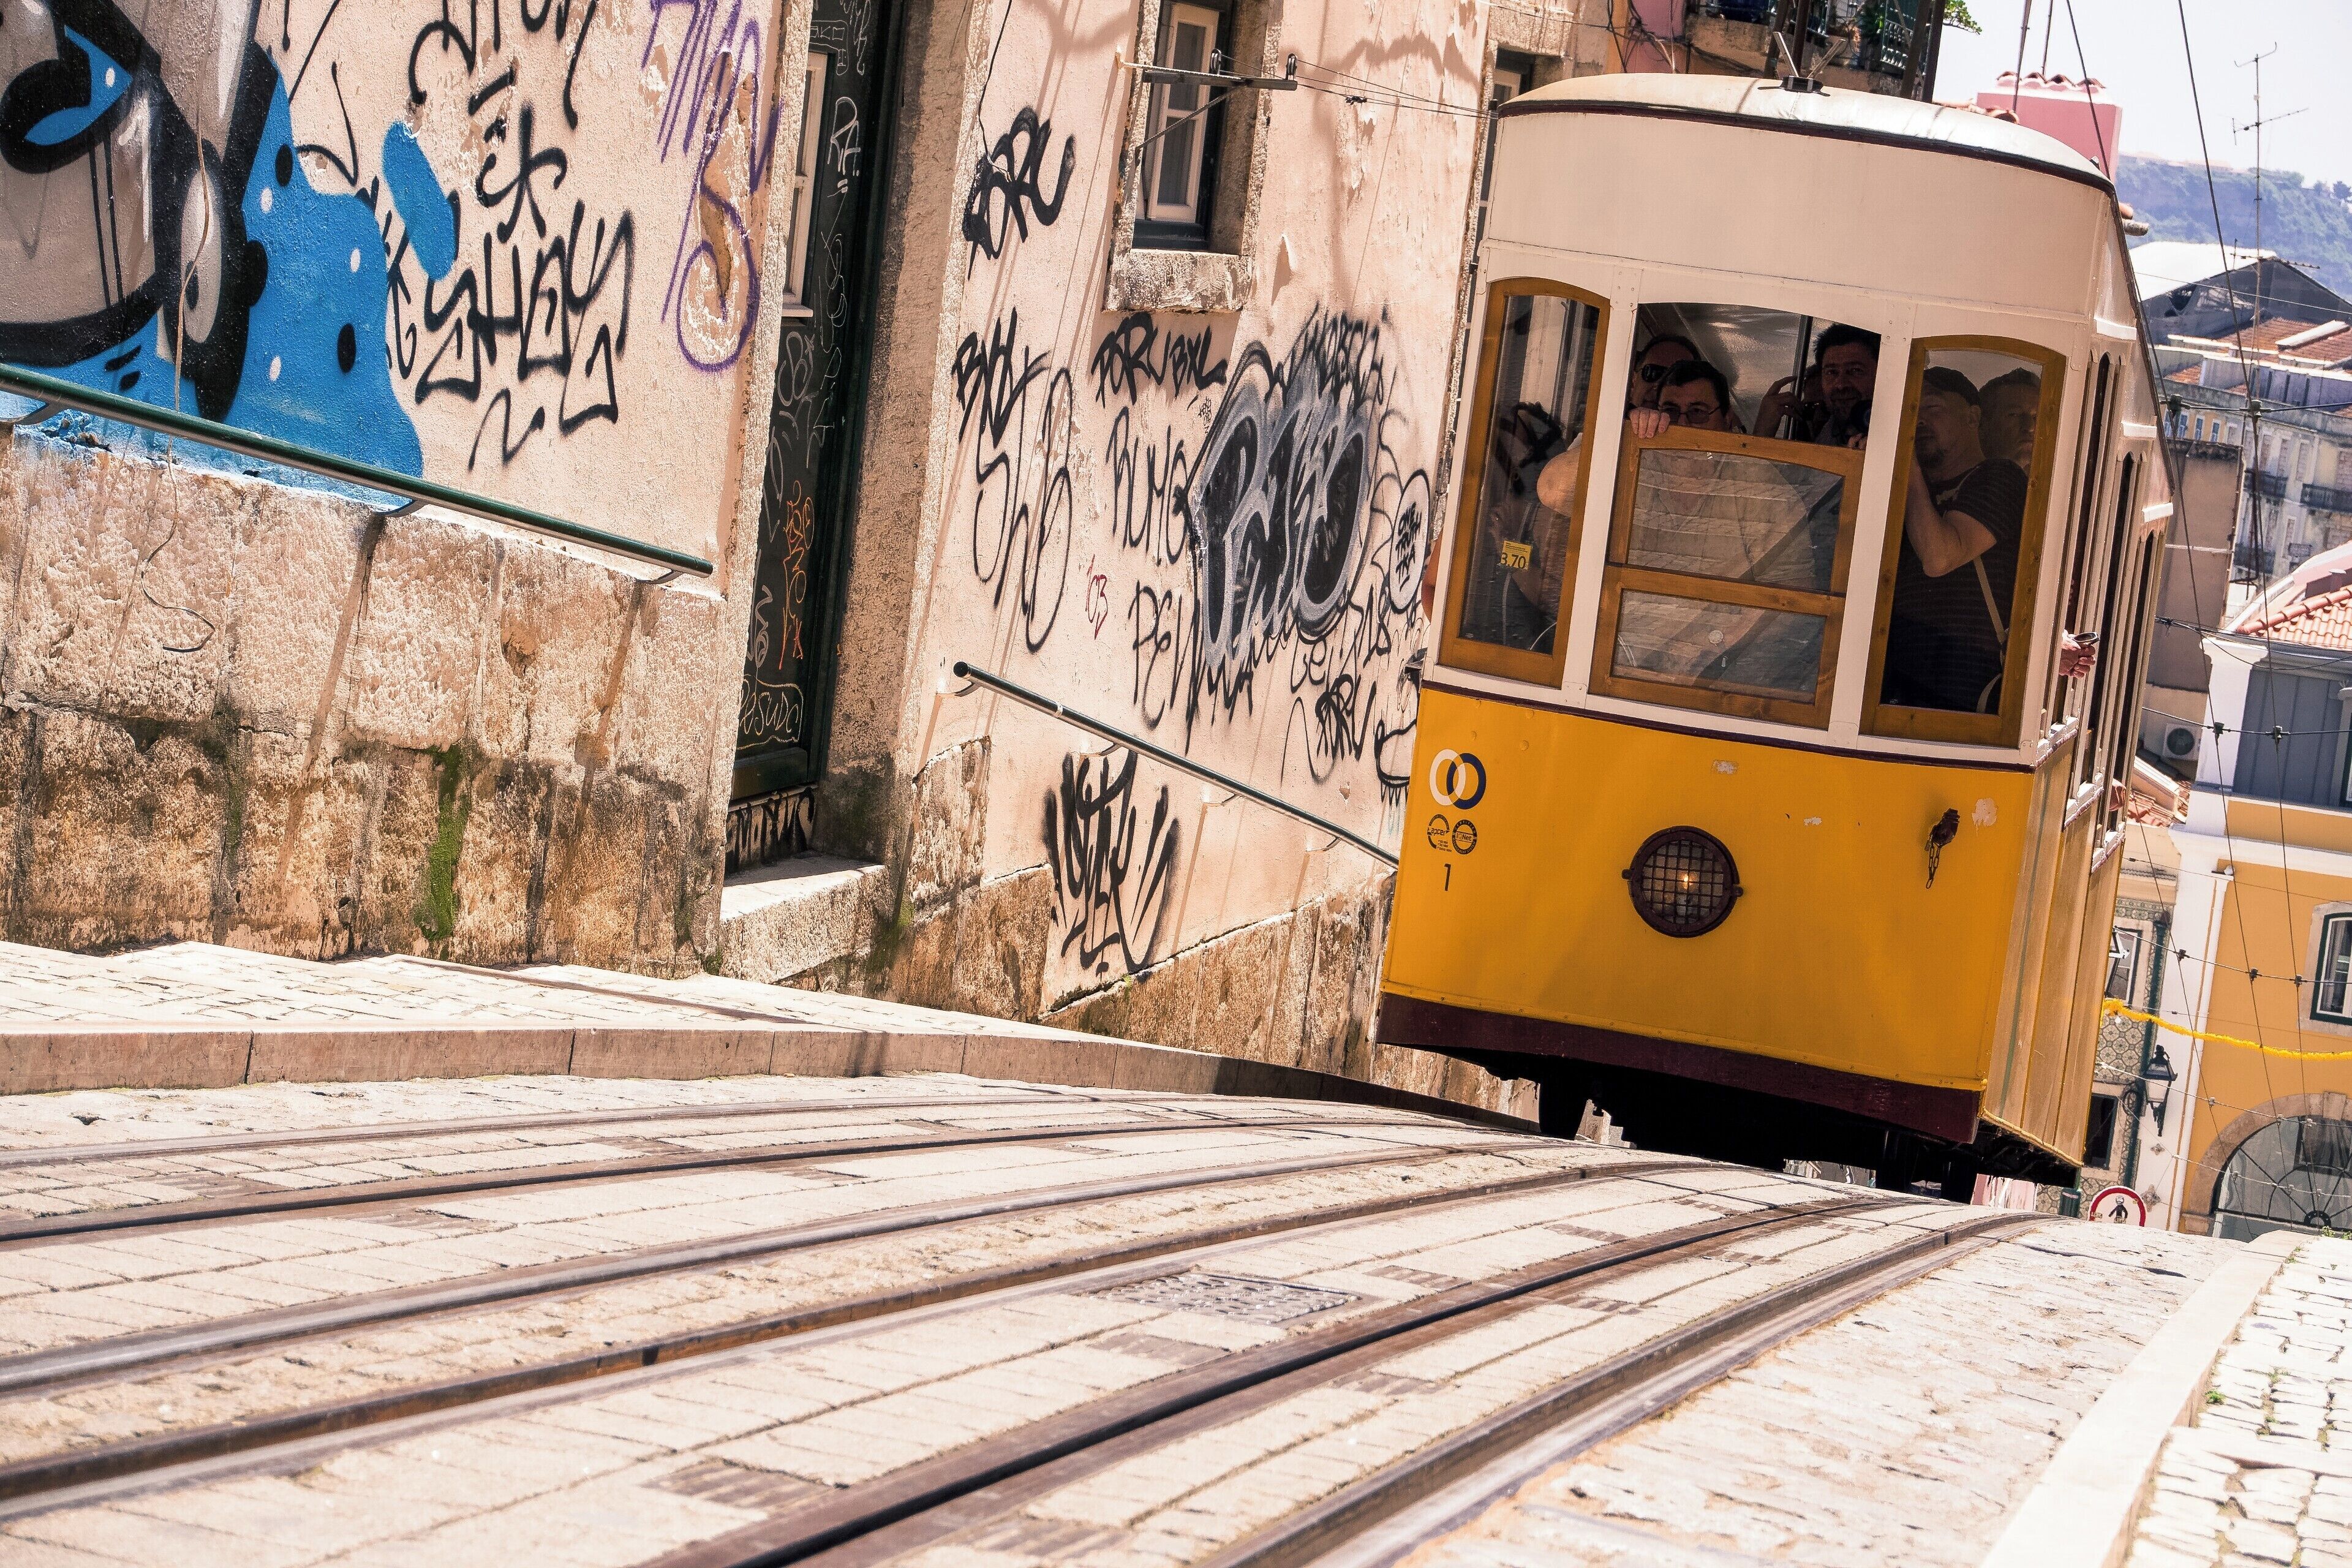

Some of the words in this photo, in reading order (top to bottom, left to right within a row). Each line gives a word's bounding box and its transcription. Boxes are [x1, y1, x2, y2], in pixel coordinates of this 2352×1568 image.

[1398, 501, 1417, 537] ONE
[1395, 510, 1423, 561] TRUTH
[1456, 832, 1472, 842] IQNet
[1444, 863, 1452, 892] 1
